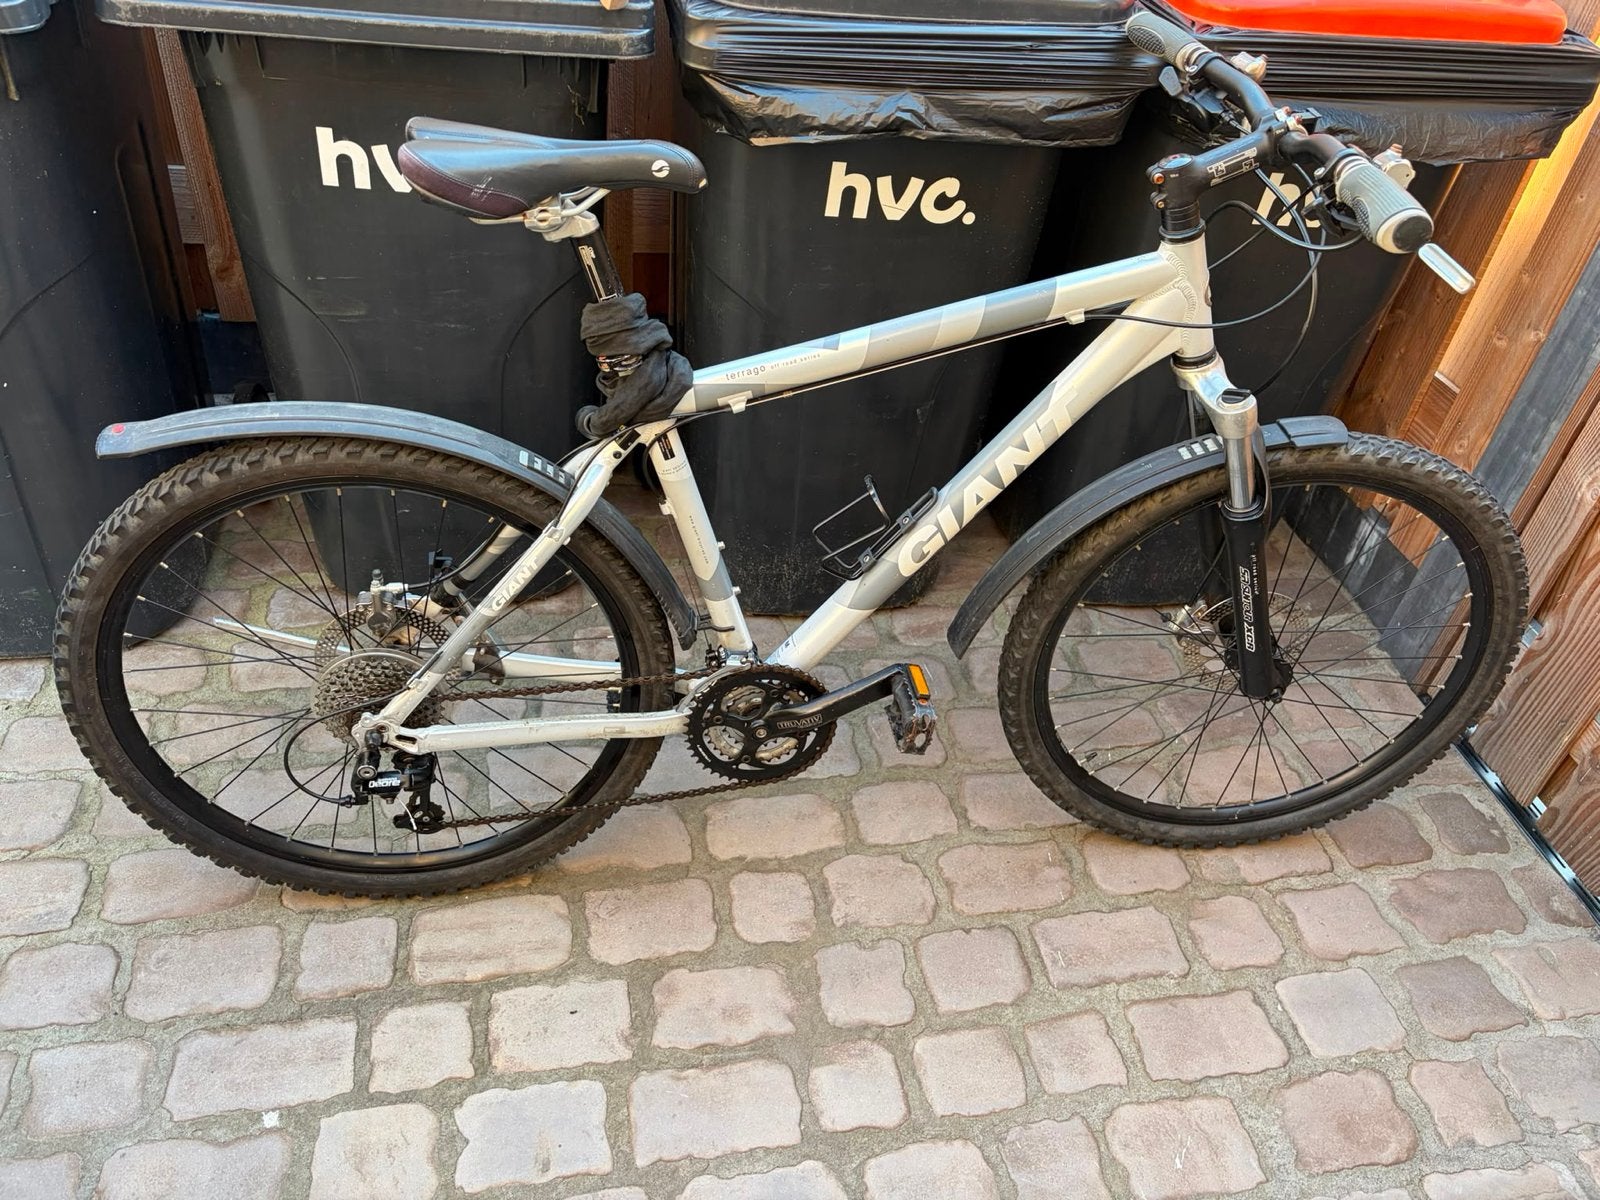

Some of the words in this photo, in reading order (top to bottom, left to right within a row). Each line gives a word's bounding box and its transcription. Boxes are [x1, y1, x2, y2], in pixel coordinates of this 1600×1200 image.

[824, 161, 976, 225] hvc.
[725, 365, 766, 381] terrago
[898, 387, 1078, 577] GIANT
[491, 556, 538, 611] GIANT
[1239, 565, 1251, 586] SR
[1241, 584, 1254, 623] SUNTOUR
[1244, 622, 1256, 653] XCR
[777, 713, 823, 729] TRUVATIV
[368, 779, 401, 788] Deore
